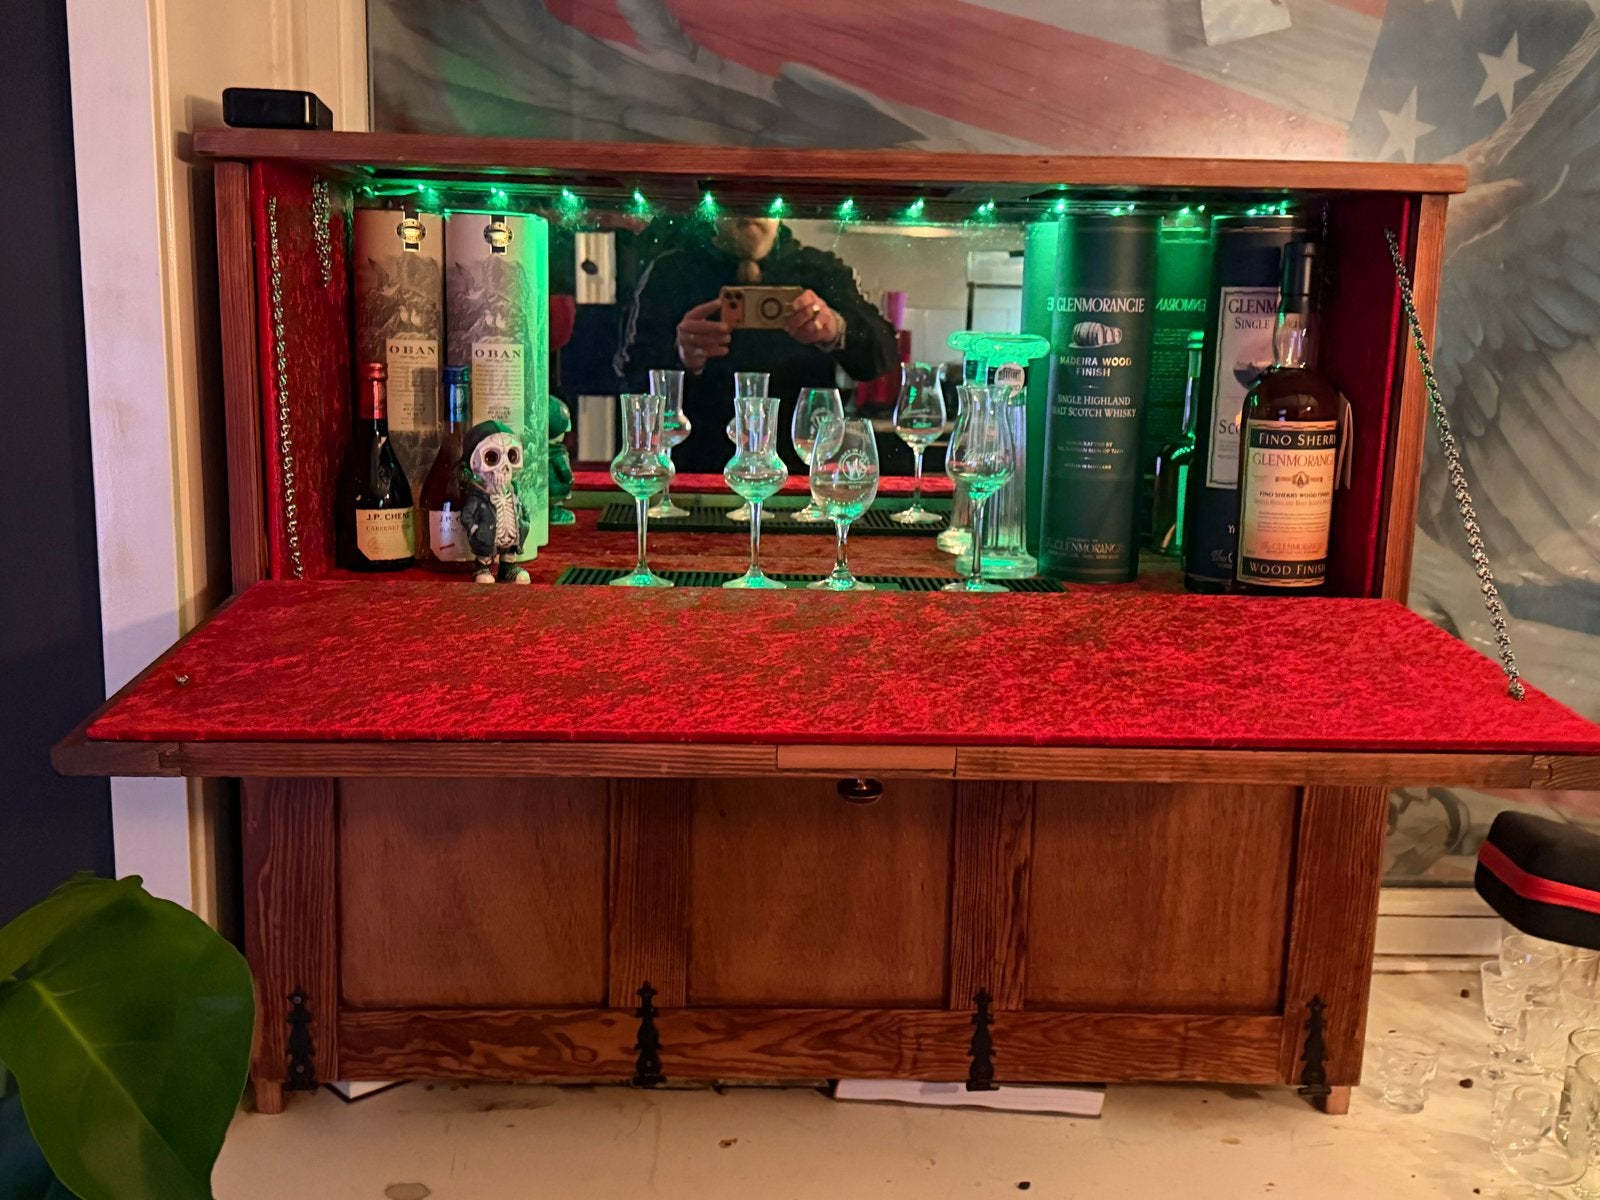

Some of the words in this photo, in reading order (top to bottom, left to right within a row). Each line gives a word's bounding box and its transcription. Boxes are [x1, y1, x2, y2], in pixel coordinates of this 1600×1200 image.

[1056, 297, 1145, 313] GLENMORANGIE
[1234, 316, 1270, 329] SINGLE
[389, 345, 436, 355] OBAN
[475, 349, 521, 359] OBAN
[1060, 357, 1098, 367] MADEIRA
[1102, 357, 1132, 367] WOOD
[1076, 368, 1111, 377] FINISH
[1083, 395, 1131, 406] HIGHLAND
[1068, 406, 1102, 418] SCOTCH
[1103, 408, 1137, 419] WHISKY
[1259, 432, 1292, 446] FINO
[366, 513, 382, 521] J.P.
[1249, 561, 1292, 576] WOOD
